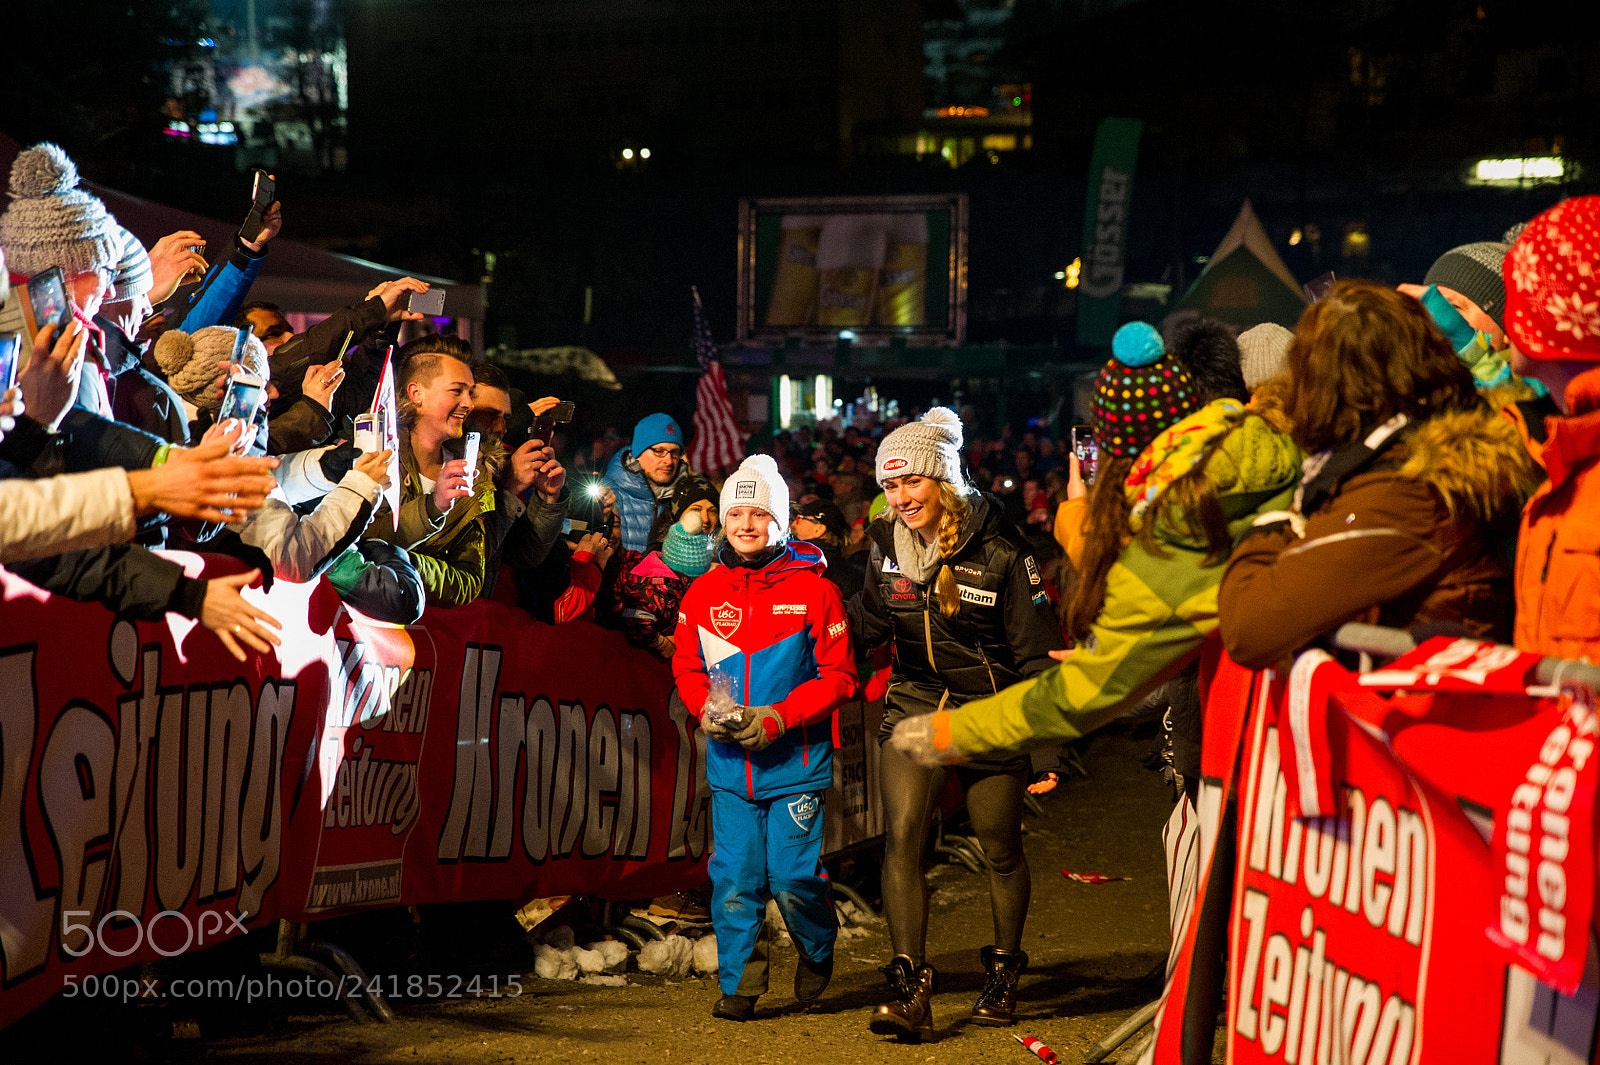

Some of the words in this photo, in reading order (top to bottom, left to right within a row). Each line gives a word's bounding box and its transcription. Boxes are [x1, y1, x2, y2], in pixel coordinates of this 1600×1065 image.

[885, 459, 906, 469] Barilla
[718, 609, 737, 619] USC
[828, 620, 848, 636] HEA
[327, 637, 431, 735] Kronen
[437, 641, 652, 866] Kronen
[324, 734, 420, 836] Zeitung
[797, 802, 814, 813] USC
[1500, 722, 1572, 946] eitung
